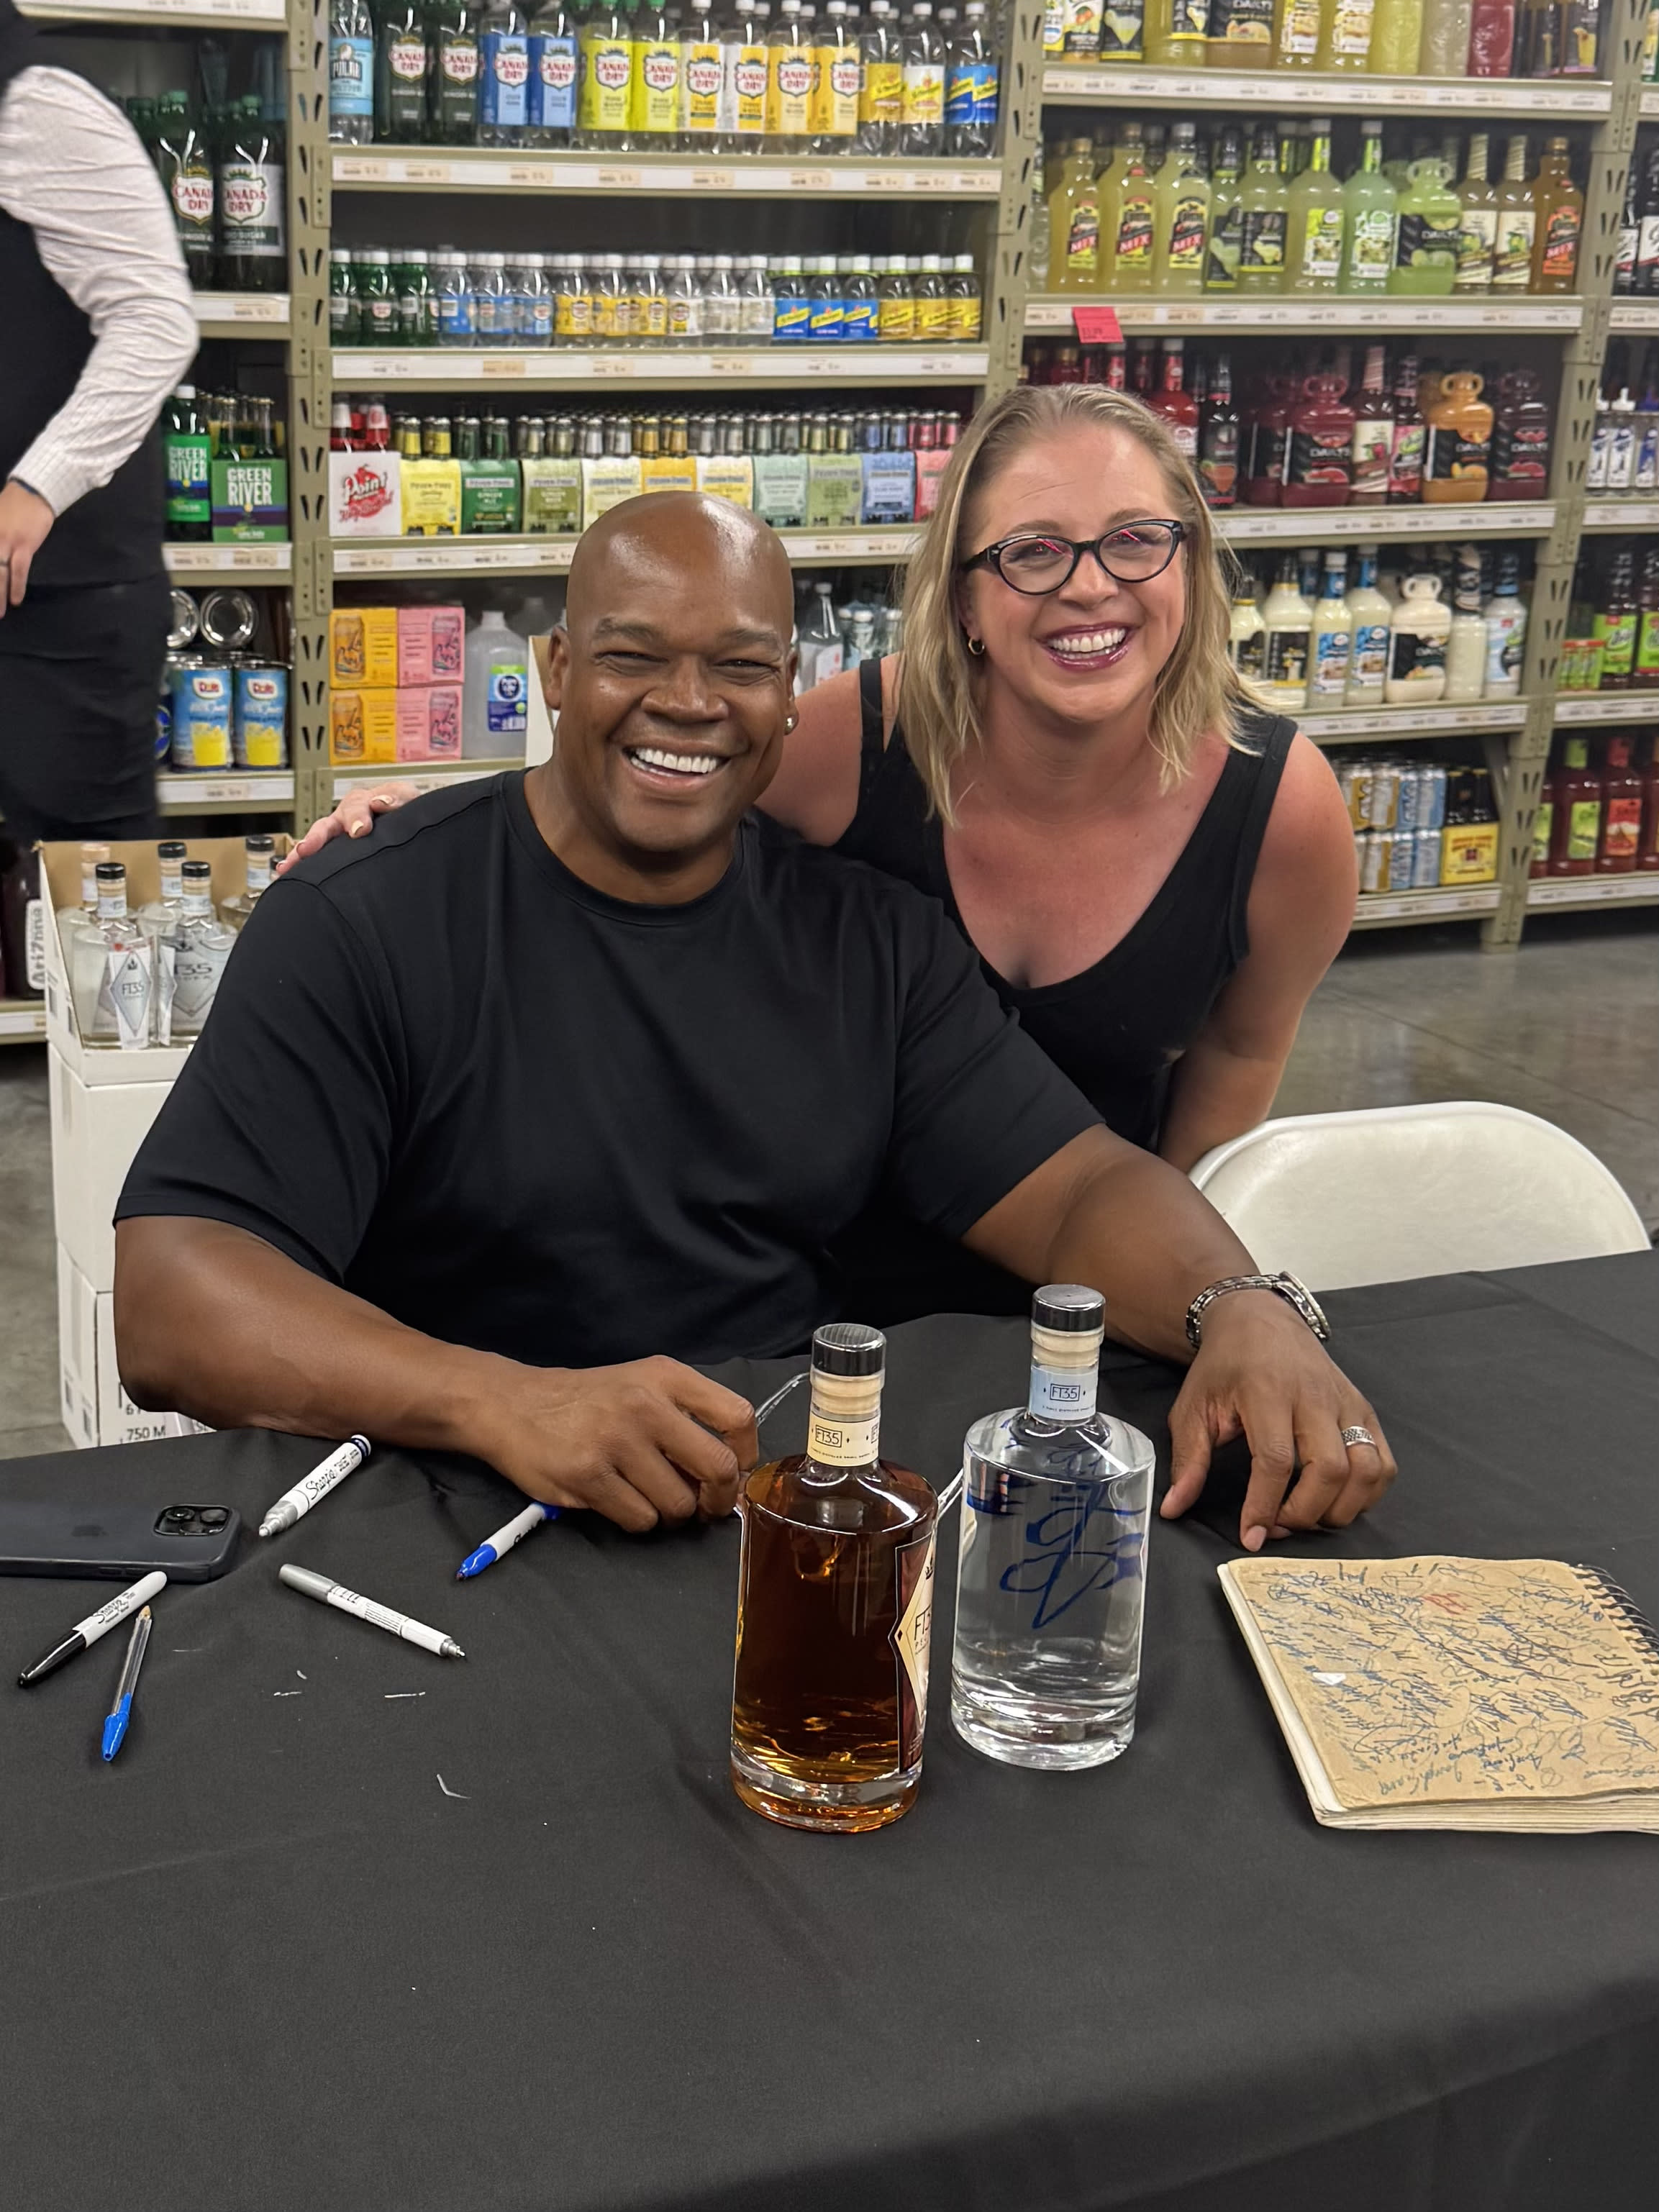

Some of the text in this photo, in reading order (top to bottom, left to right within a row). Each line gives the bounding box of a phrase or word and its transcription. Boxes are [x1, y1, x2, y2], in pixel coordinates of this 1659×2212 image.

[224, 188, 266, 201] ANADA
[228, 201, 253, 212] DRY
[170, 447, 207, 460] GREEN
[169, 460, 207, 481] RIVER
[227, 469, 271, 483] GREEN
[227, 483, 272, 505] RIVER
[174, 963, 213, 975] T35
[1053, 1385, 1078, 1400] FT35
[127, 1428, 150, 1442] 750
[817, 1428, 840, 1444] FT35
[914, 1603, 932, 1641] FT3
